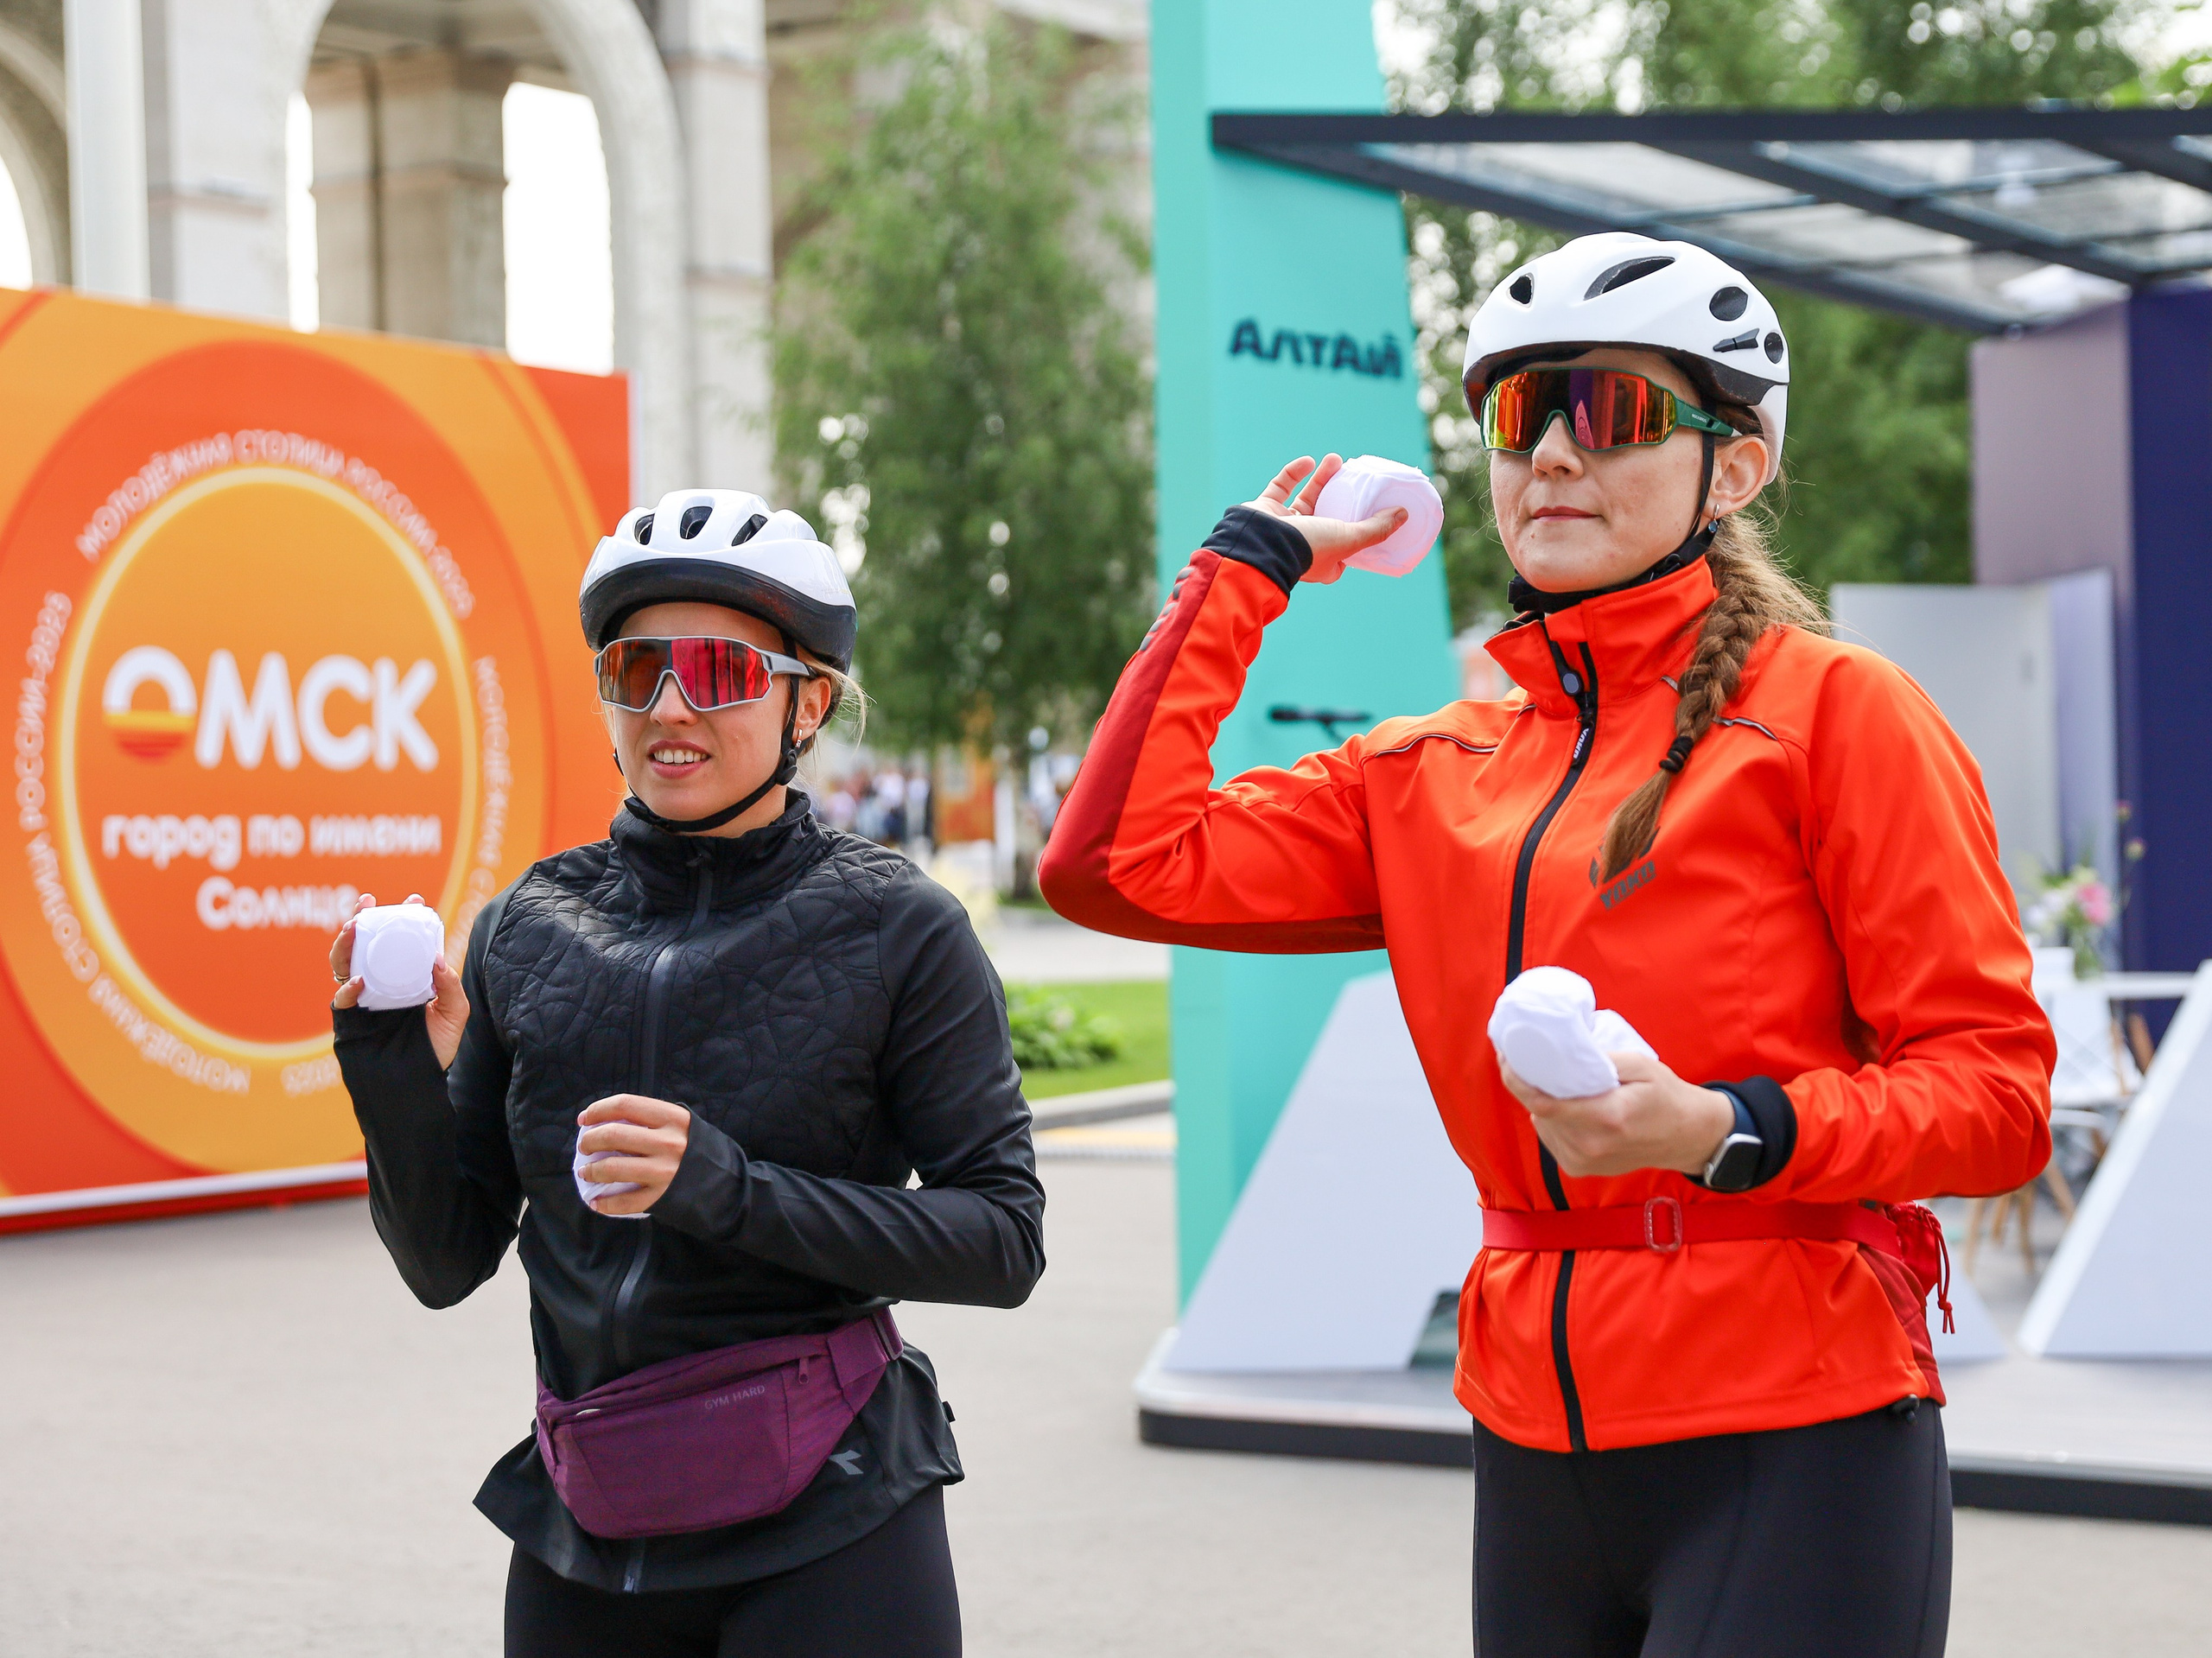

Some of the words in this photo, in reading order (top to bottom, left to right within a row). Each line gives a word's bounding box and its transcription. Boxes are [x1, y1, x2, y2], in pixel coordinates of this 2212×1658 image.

[102, 645, 439, 771] ОМСК
[102, 815, 241, 871] город
[248, 815, 304, 856] по
[309, 815, 442, 857] имени
[196, 875, 358, 932] Солнце
[1599, 860, 1656, 911] YOKO
[704, 1394, 729, 1410] GYM
[732, 1385, 766, 1401] HARD
